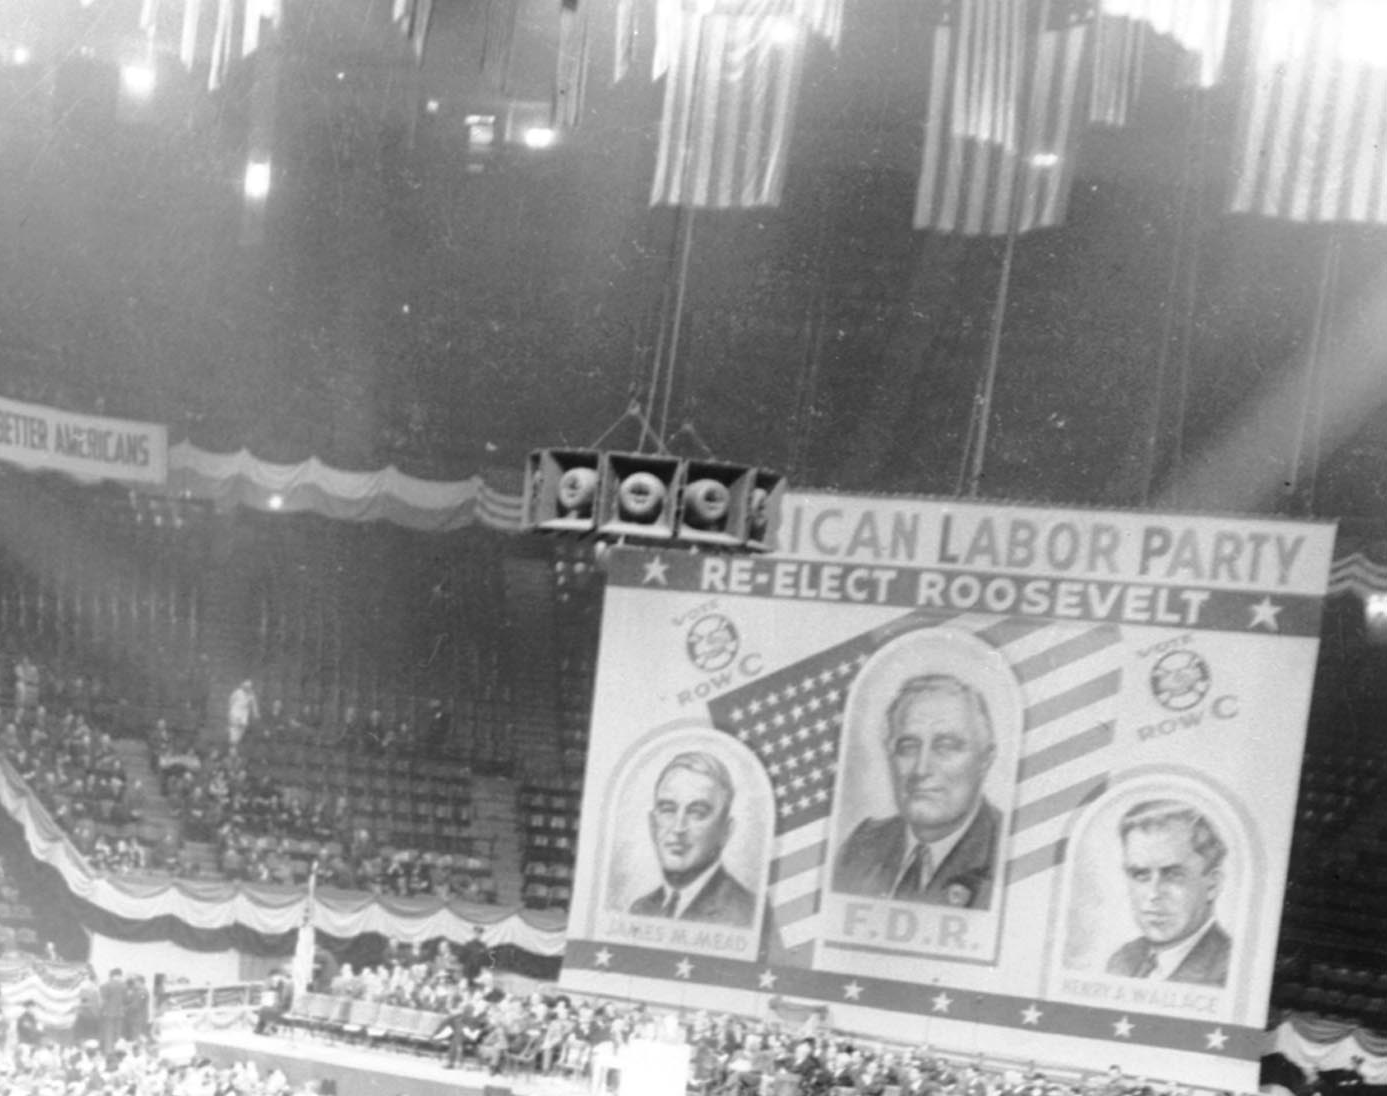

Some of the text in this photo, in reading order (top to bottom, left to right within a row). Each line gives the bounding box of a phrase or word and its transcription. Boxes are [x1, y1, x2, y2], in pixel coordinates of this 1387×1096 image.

[54, 422, 150, 467] AMERICANS
[937, 513, 1121, 575] LABOR
[1138, 525, 1306, 585] PARTY
[701, 557, 1211, 625] RE-ELECT ROOSEVELT
[676, 652, 764, 706] ROW C
[1137, 694, 1240, 741] ROW C
[694, 930, 748, 952] MEAD
[842, 902, 979, 951] F.D.R.
